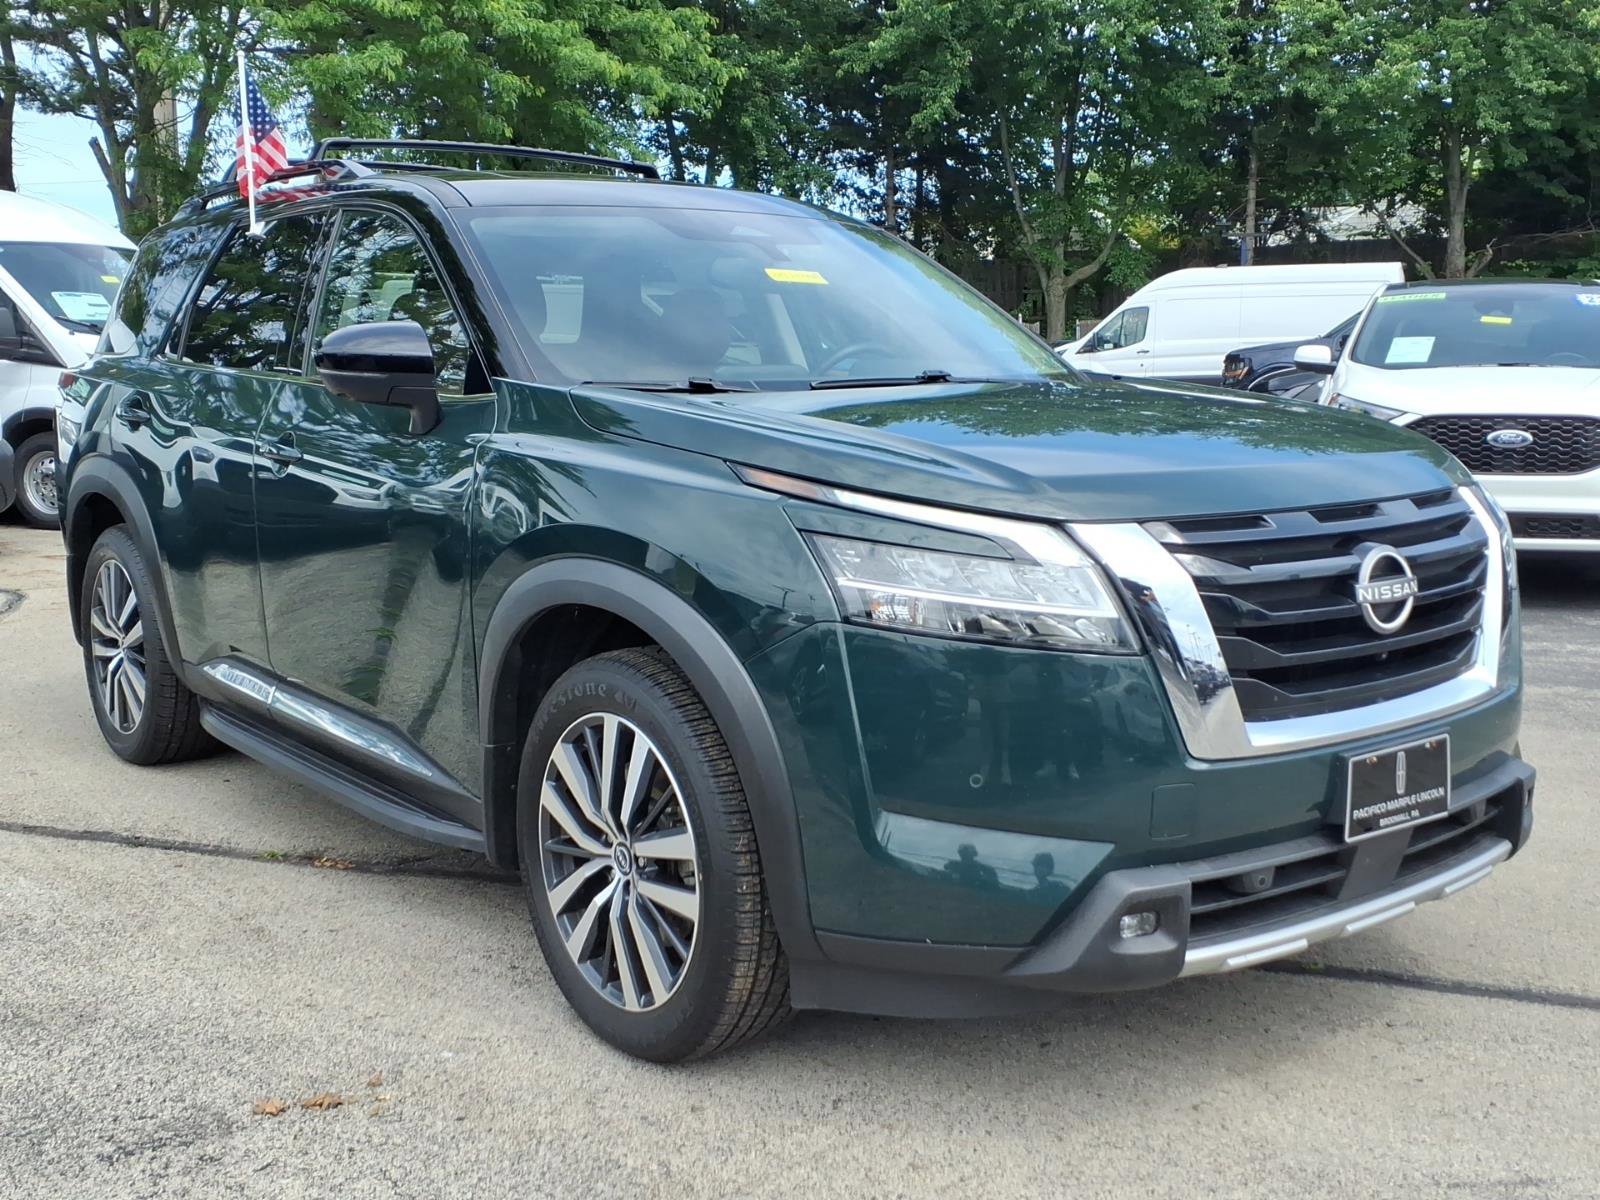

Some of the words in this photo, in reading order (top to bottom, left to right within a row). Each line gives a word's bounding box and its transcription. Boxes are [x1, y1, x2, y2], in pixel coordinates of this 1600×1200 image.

[1359, 580, 1418, 601] NISSAN
[1353, 802, 1387, 820] PACIFICO
[1387, 795, 1417, 810] MARPLE
[1417, 787, 1445, 803] LINCOLN
[1411, 808, 1420, 817] PA
